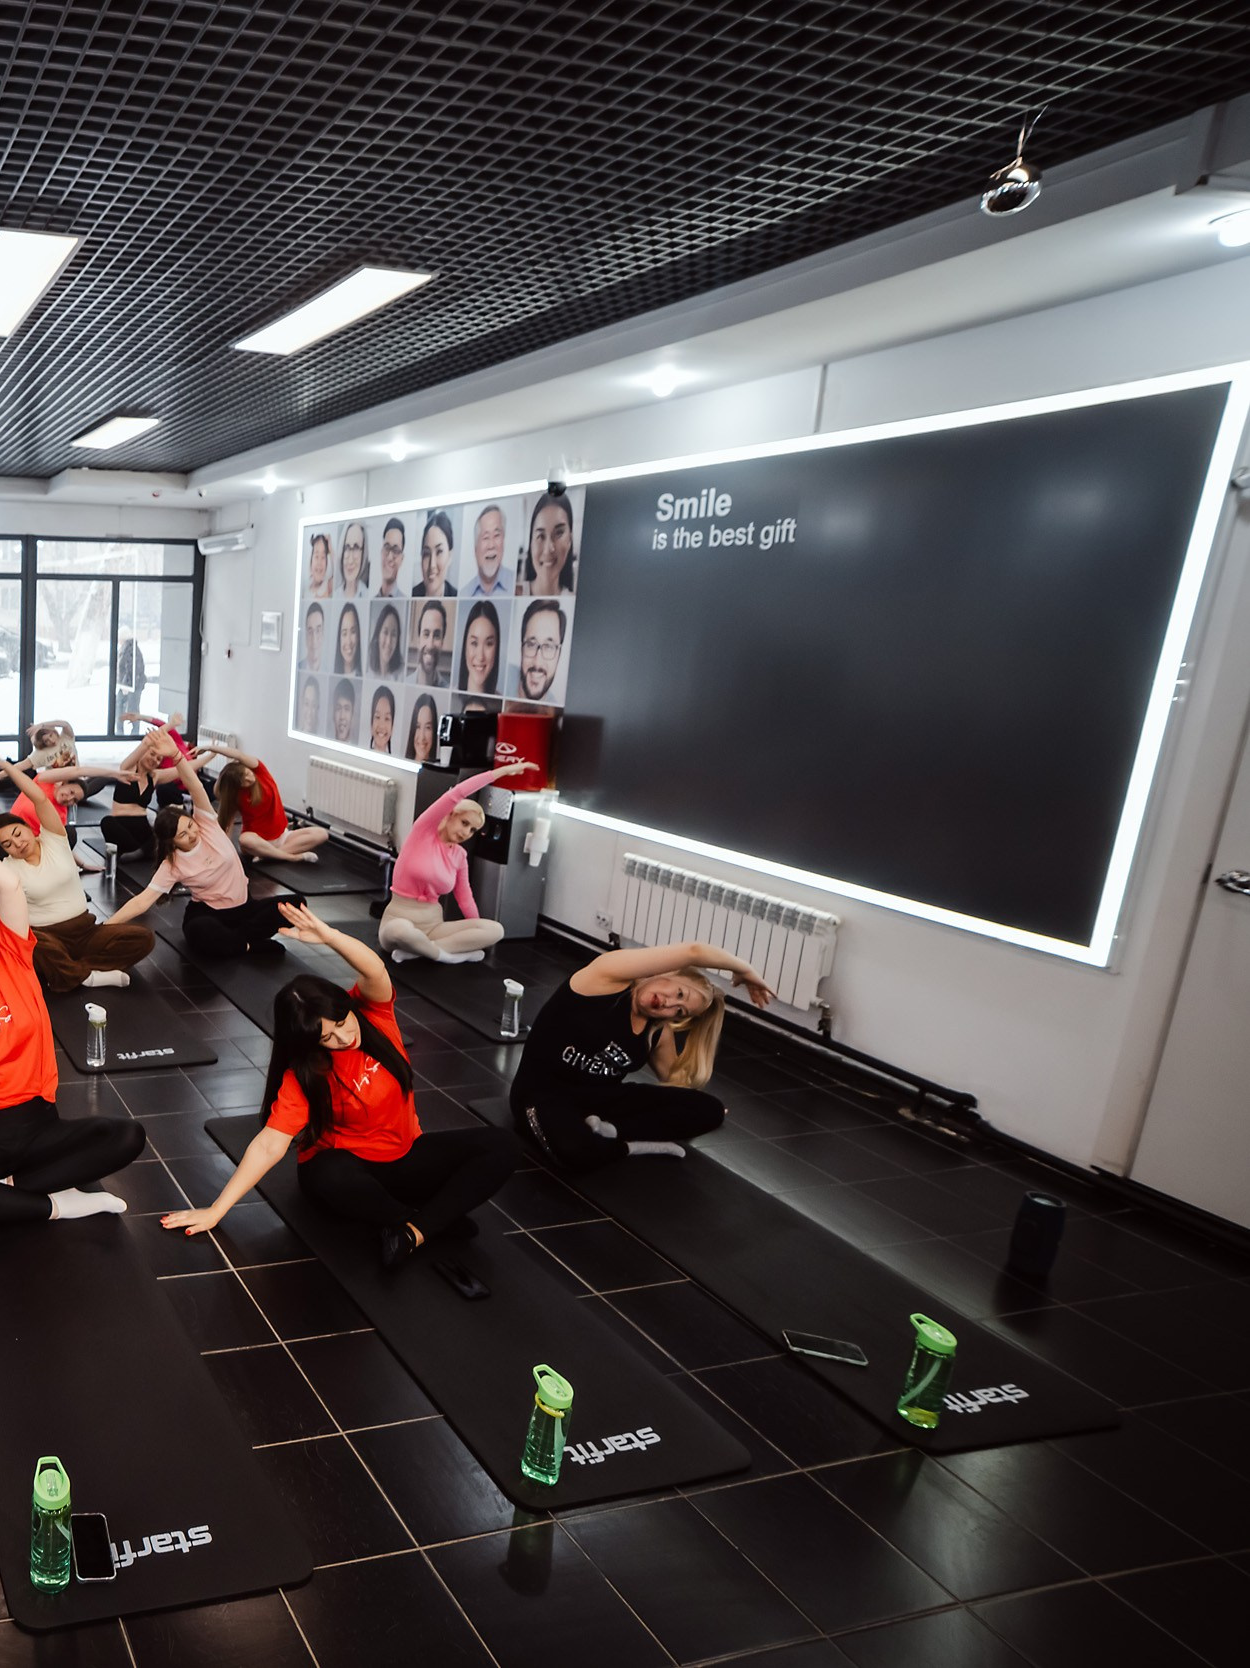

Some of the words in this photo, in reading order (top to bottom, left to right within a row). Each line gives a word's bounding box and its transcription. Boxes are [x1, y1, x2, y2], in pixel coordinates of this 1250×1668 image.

[656, 487, 733, 522] Smile
[652, 529, 668, 551] is
[672, 526, 704, 550] the
[708, 521, 755, 548] best
[759, 517, 798, 550] gift
[116, 1047, 175, 1060] starfit
[563, 1426, 662, 1465] starfit
[110, 1524, 213, 1569] starfi
